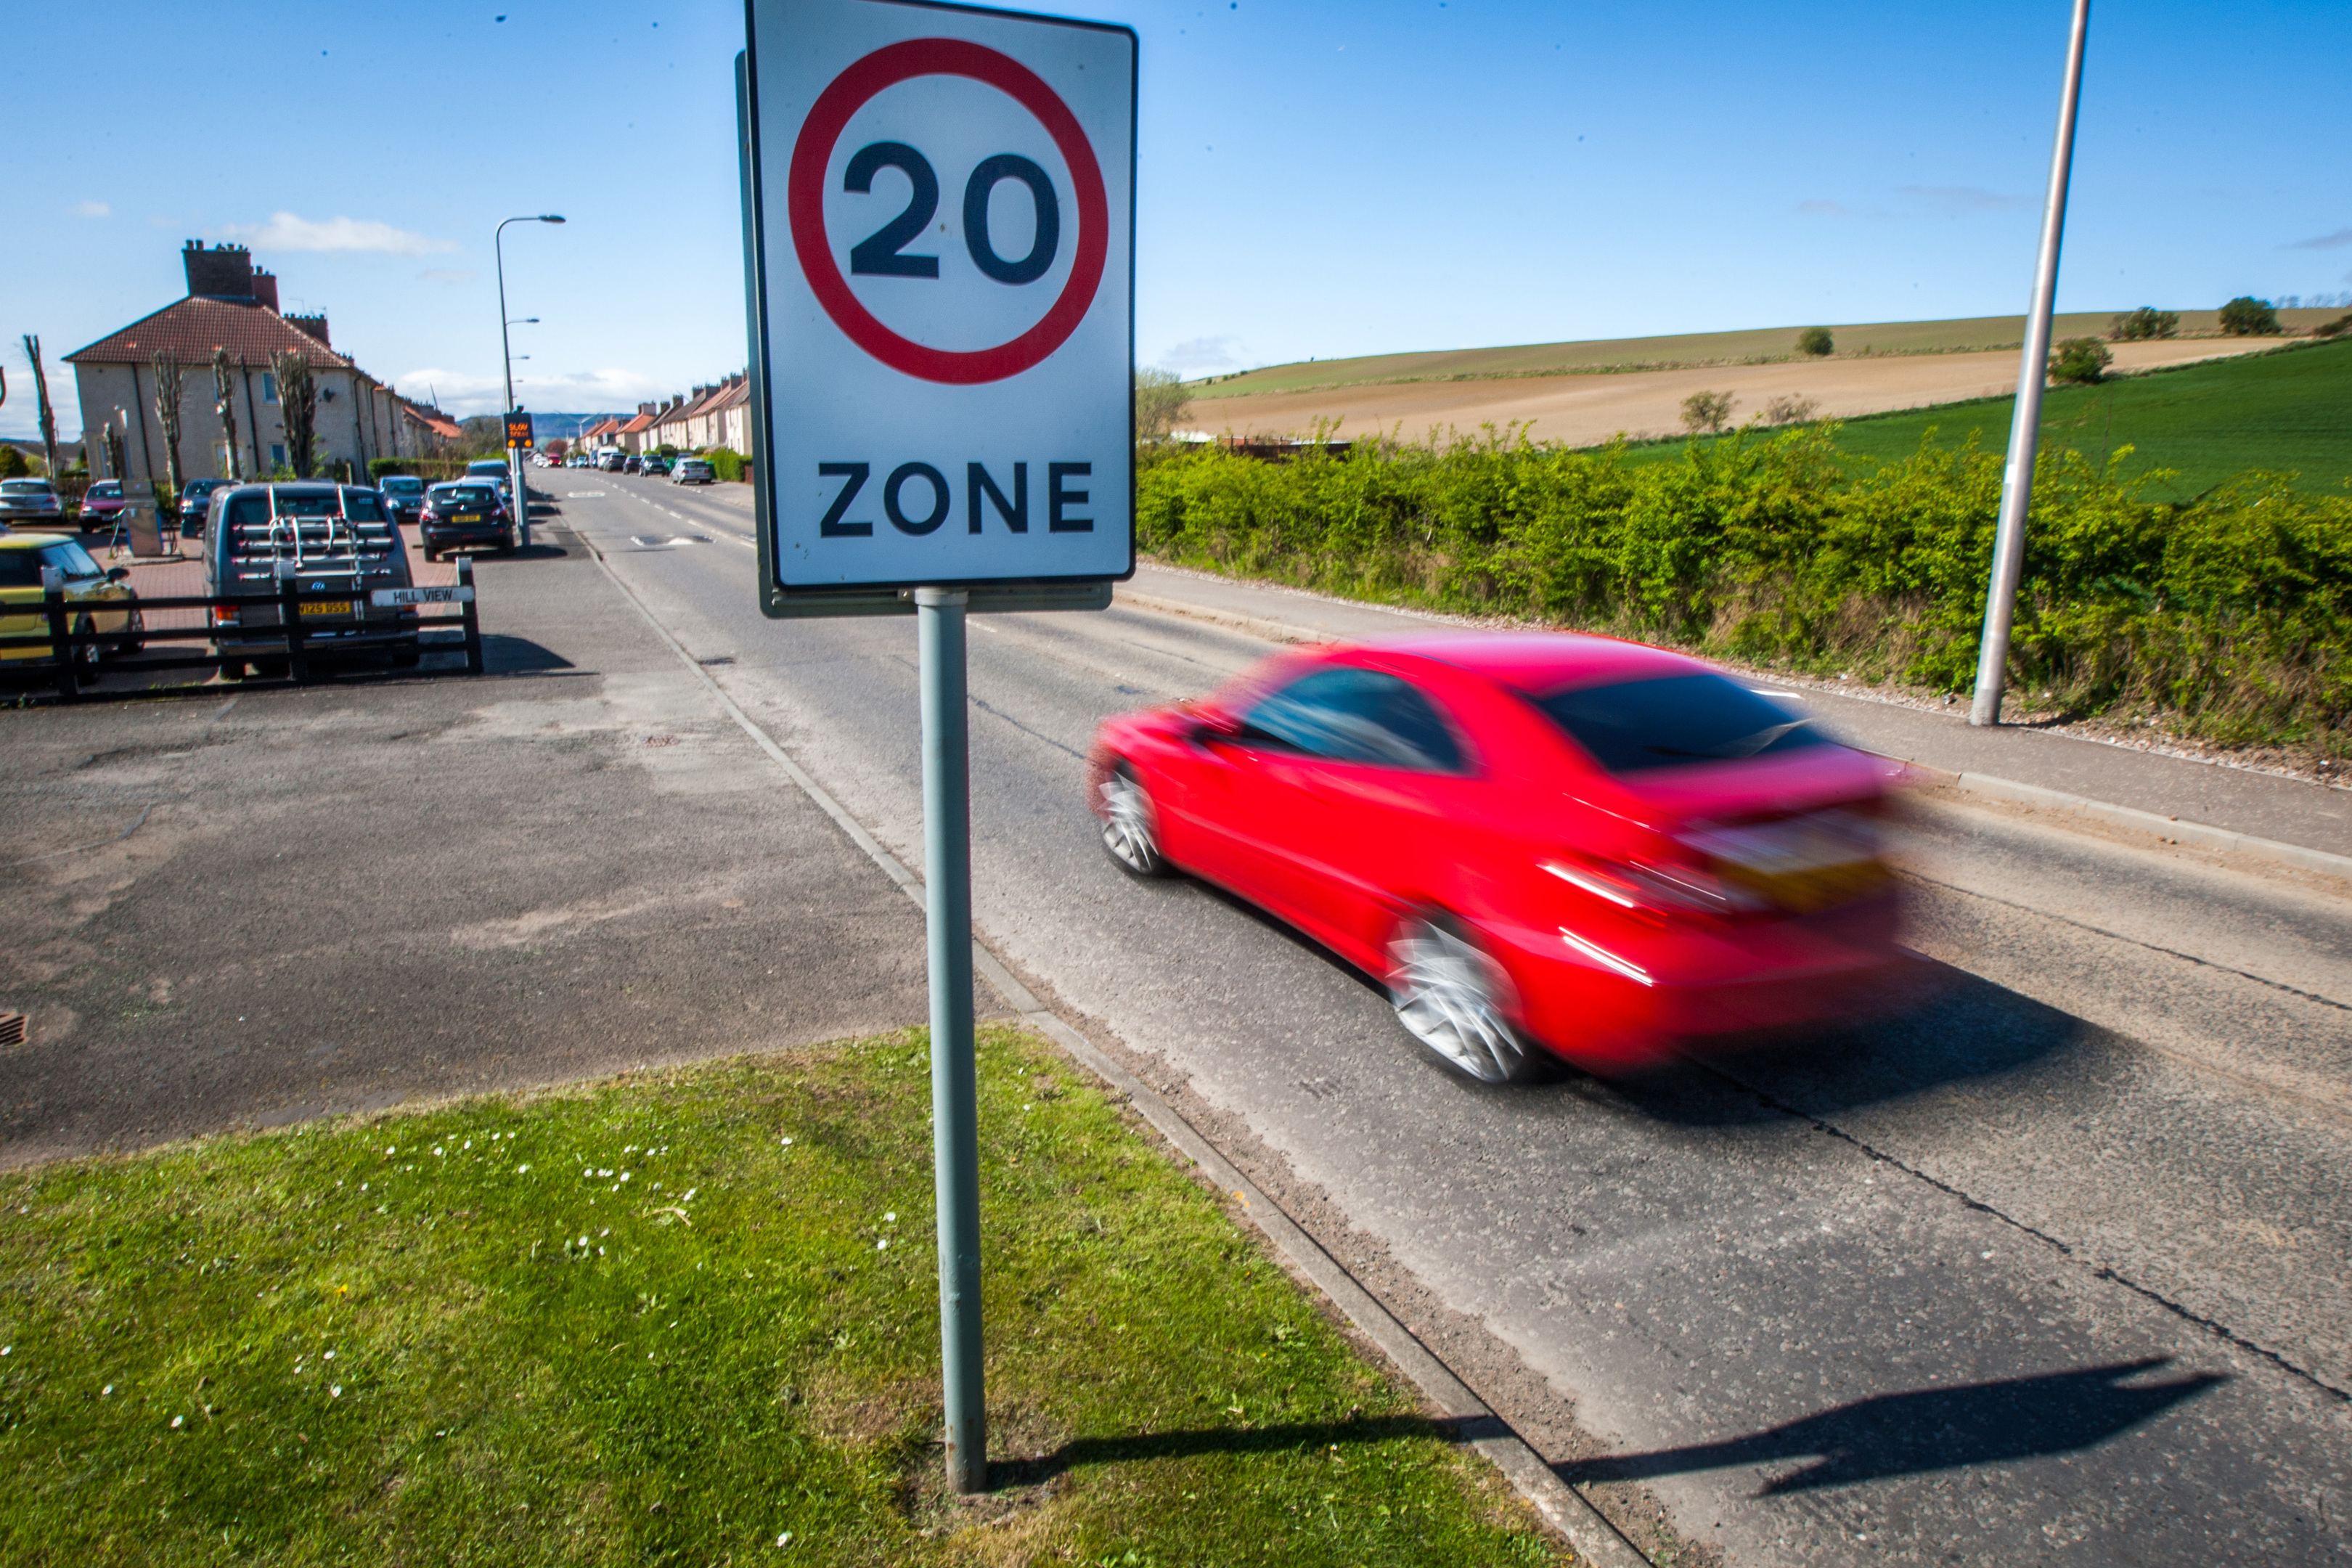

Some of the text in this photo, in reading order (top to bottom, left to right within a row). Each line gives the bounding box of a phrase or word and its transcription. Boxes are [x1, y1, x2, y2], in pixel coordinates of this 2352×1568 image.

[844, 140, 1059, 284] 20
[819, 461, 1094, 537] ZONE
[393, 589, 453, 603] HILL VIEW
